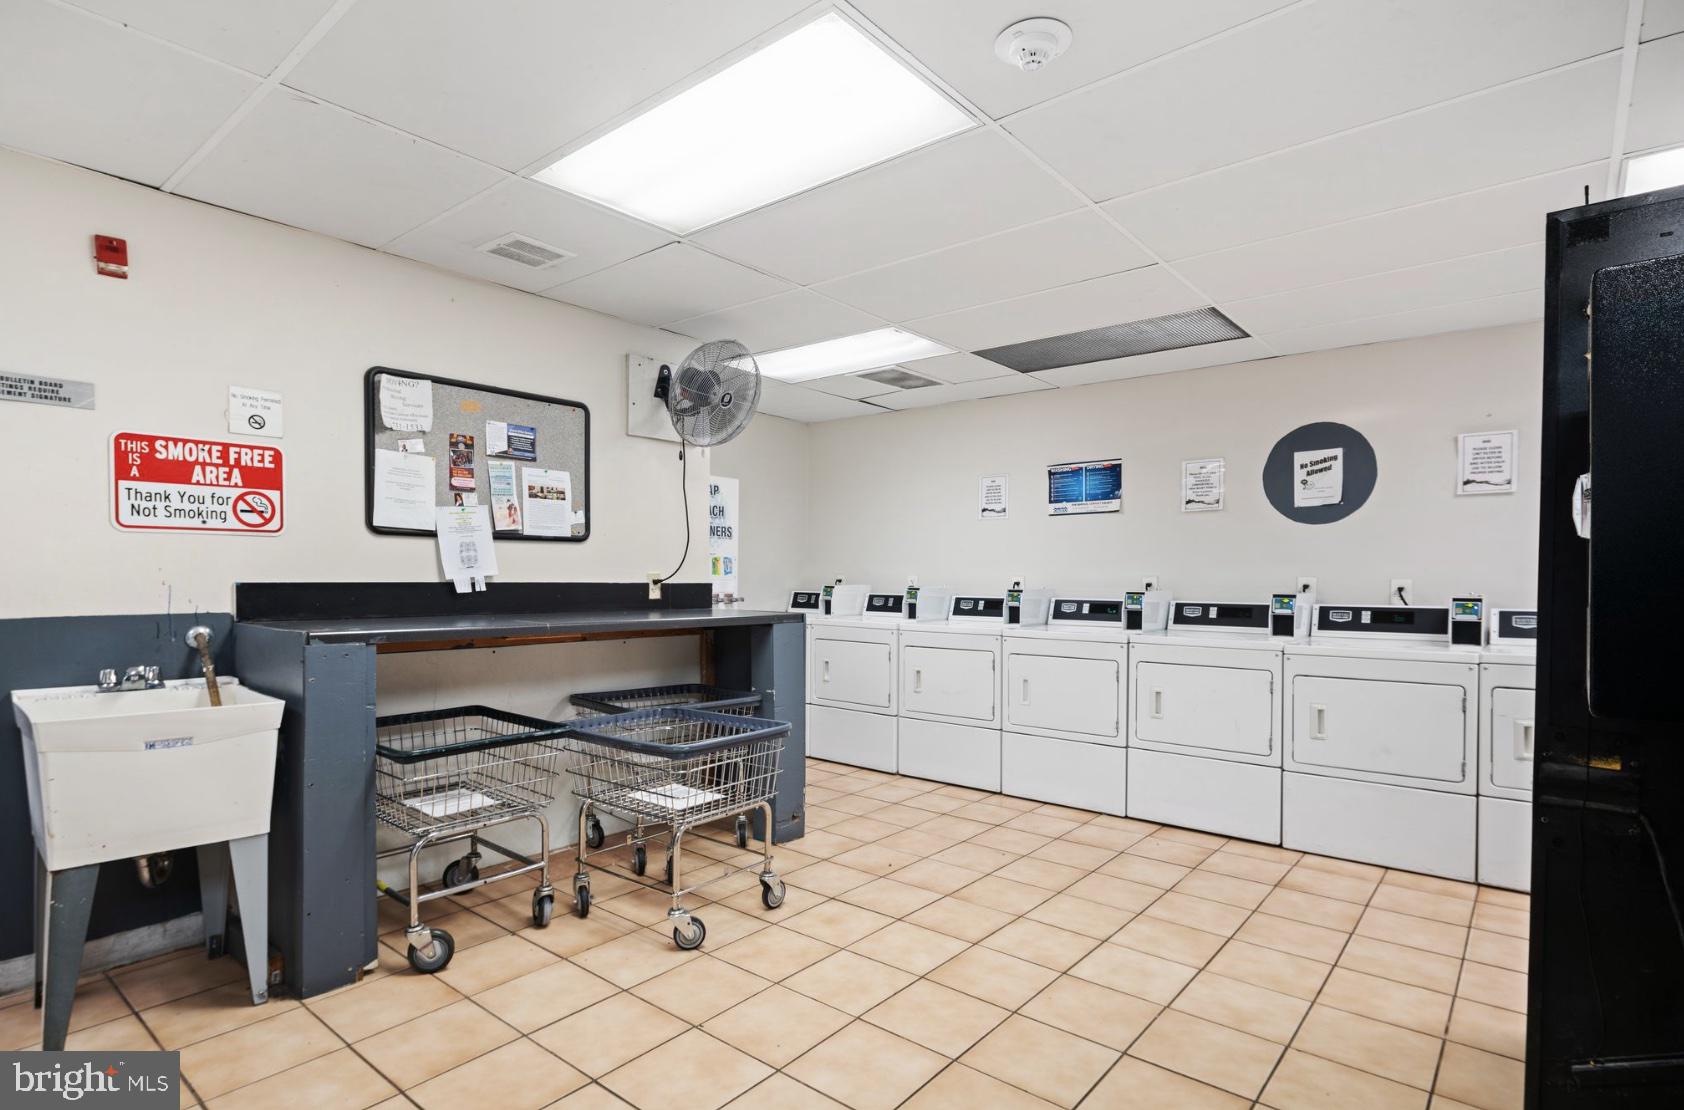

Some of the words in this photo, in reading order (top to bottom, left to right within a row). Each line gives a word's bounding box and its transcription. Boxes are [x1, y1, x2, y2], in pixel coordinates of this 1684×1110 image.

[28, 385, 60, 395] REQUIRE
[39, 380, 64, 389] BOARD
[0, 389, 27, 398] EMENT
[31, 392, 72, 403] SIGNATURE
[120, 439, 149, 453] THIS
[154, 439, 223, 465] SMOKE
[229, 446, 275, 468] FREE
[128, 453, 141, 465] IS
[1309, 454, 1338, 467] Smoking
[130, 466, 140, 478] A
[191, 465, 243, 486] AREA
[1306, 464, 1332, 477] Allowed
[125, 487, 171, 504] Thank
[177, 490, 205, 506] You
[211, 492, 232, 506] for
[130, 503, 158, 518] Not
[164, 505, 227, 523] Smoking
